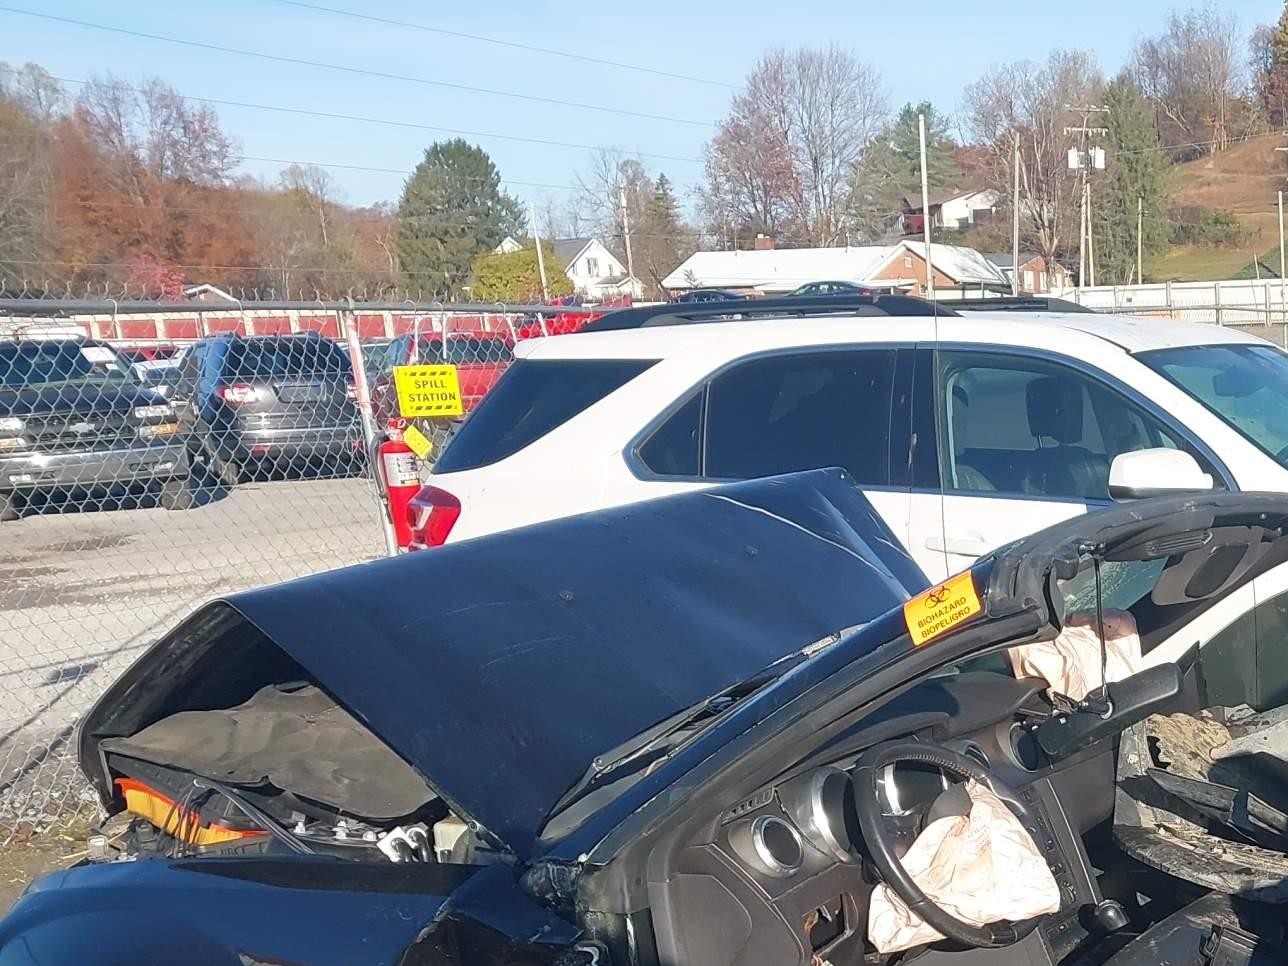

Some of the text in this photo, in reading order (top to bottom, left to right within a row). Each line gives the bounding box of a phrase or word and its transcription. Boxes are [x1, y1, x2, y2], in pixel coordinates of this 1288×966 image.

[414, 380, 447, 389] SPILL
[408, 392, 456, 402] STATION
[917, 596, 967, 628] BIOHAZARD
[921, 606, 971, 638] BIOPELIGRO
